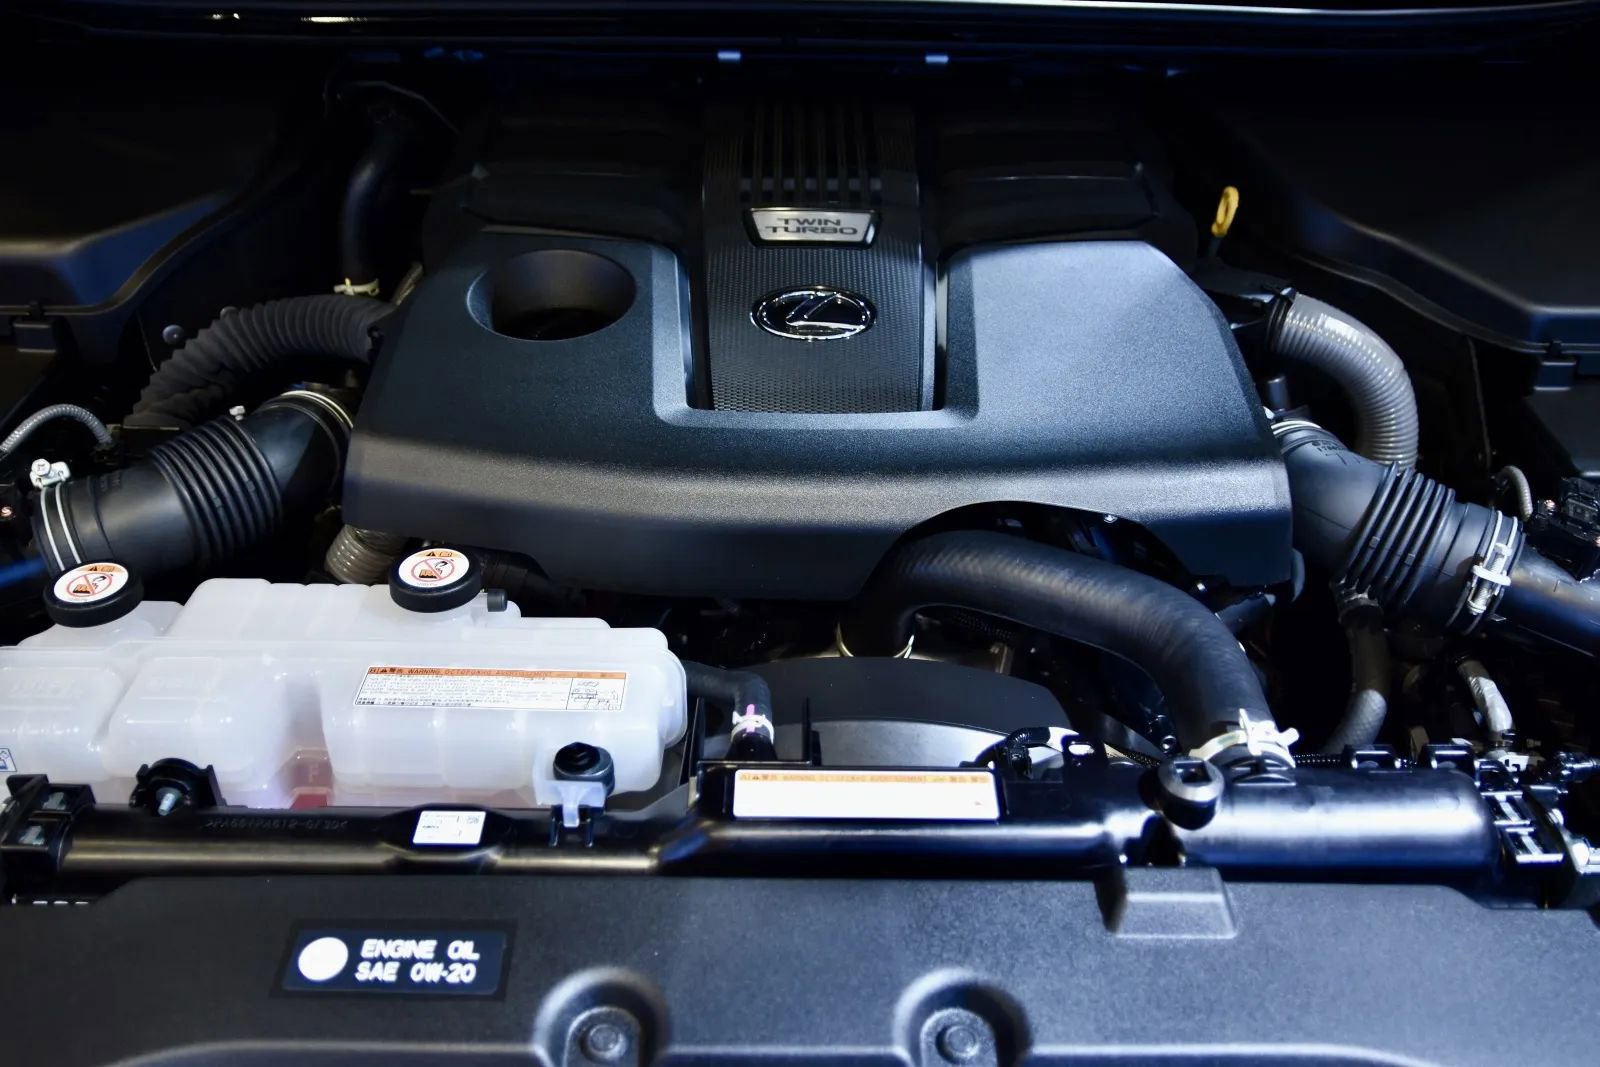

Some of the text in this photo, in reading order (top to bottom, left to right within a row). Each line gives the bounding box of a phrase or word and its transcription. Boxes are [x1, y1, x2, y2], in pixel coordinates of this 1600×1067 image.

[776, 218, 841, 226] TWIN
[765, 226, 858, 235] TURBO
[360, 939, 480, 960] ENGINE OIL
[355, 961, 399, 982] SAE
